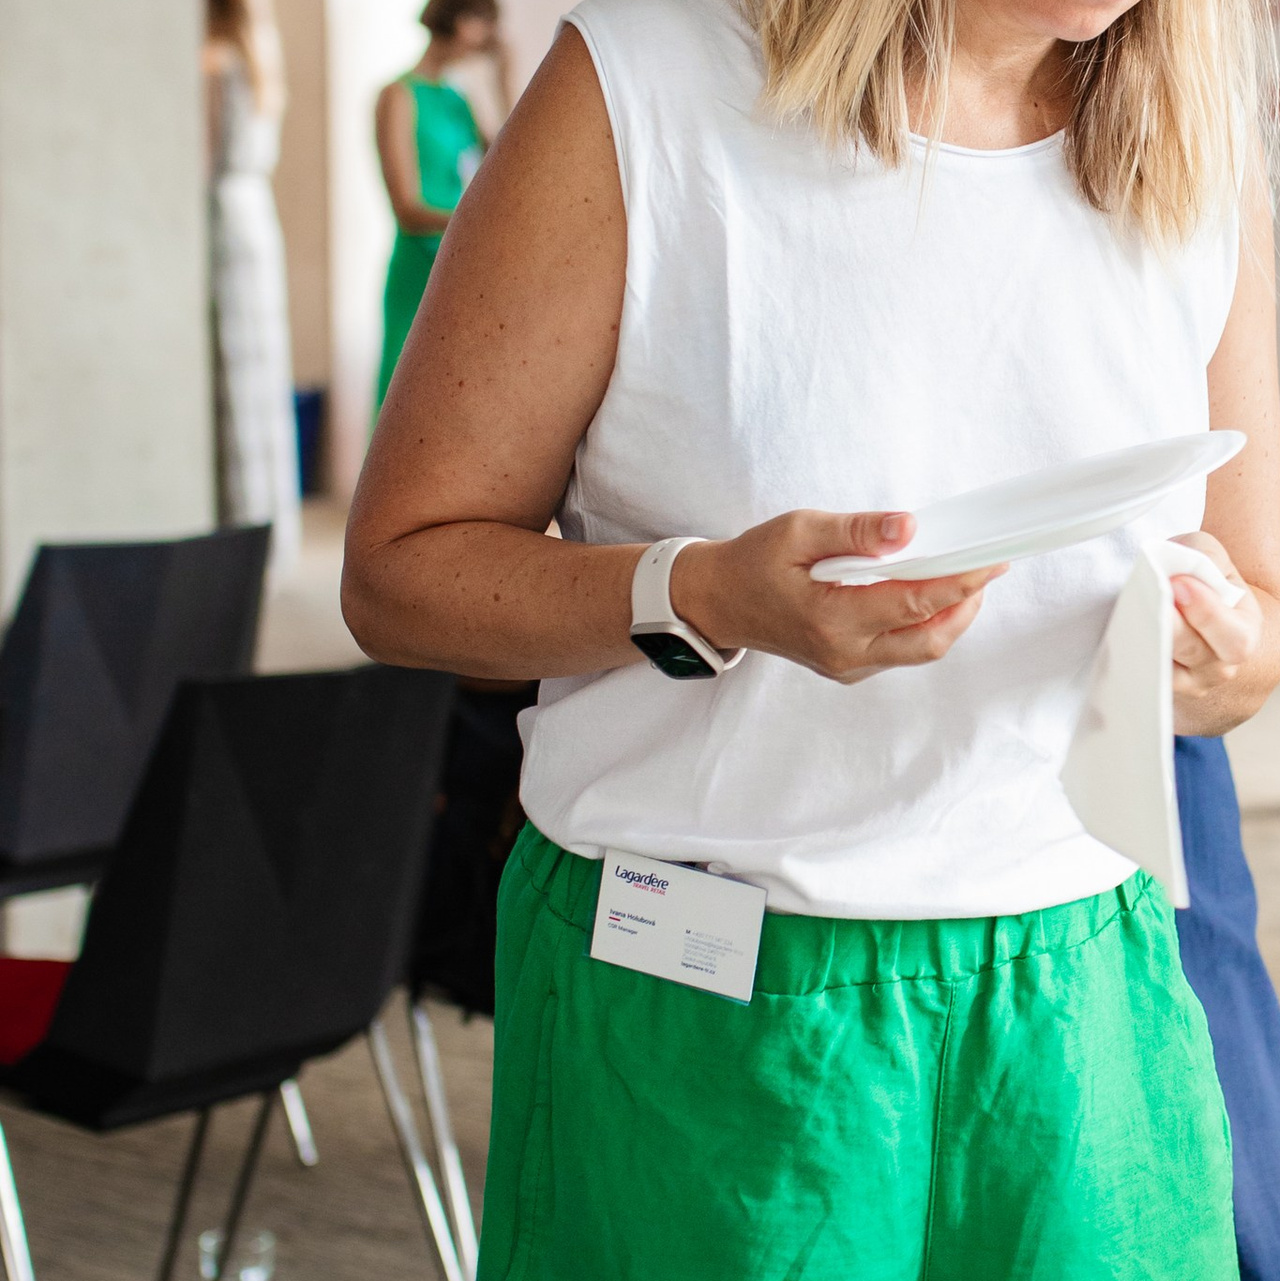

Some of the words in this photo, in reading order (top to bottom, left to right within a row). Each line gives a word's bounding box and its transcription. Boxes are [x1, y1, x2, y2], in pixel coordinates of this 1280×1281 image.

[615, 865, 669, 890] Lagardère
[633, 882, 649, 891] TRAVEL
[650, 887, 666, 896] RETAIL
[610, 908, 626, 918] Ivana
